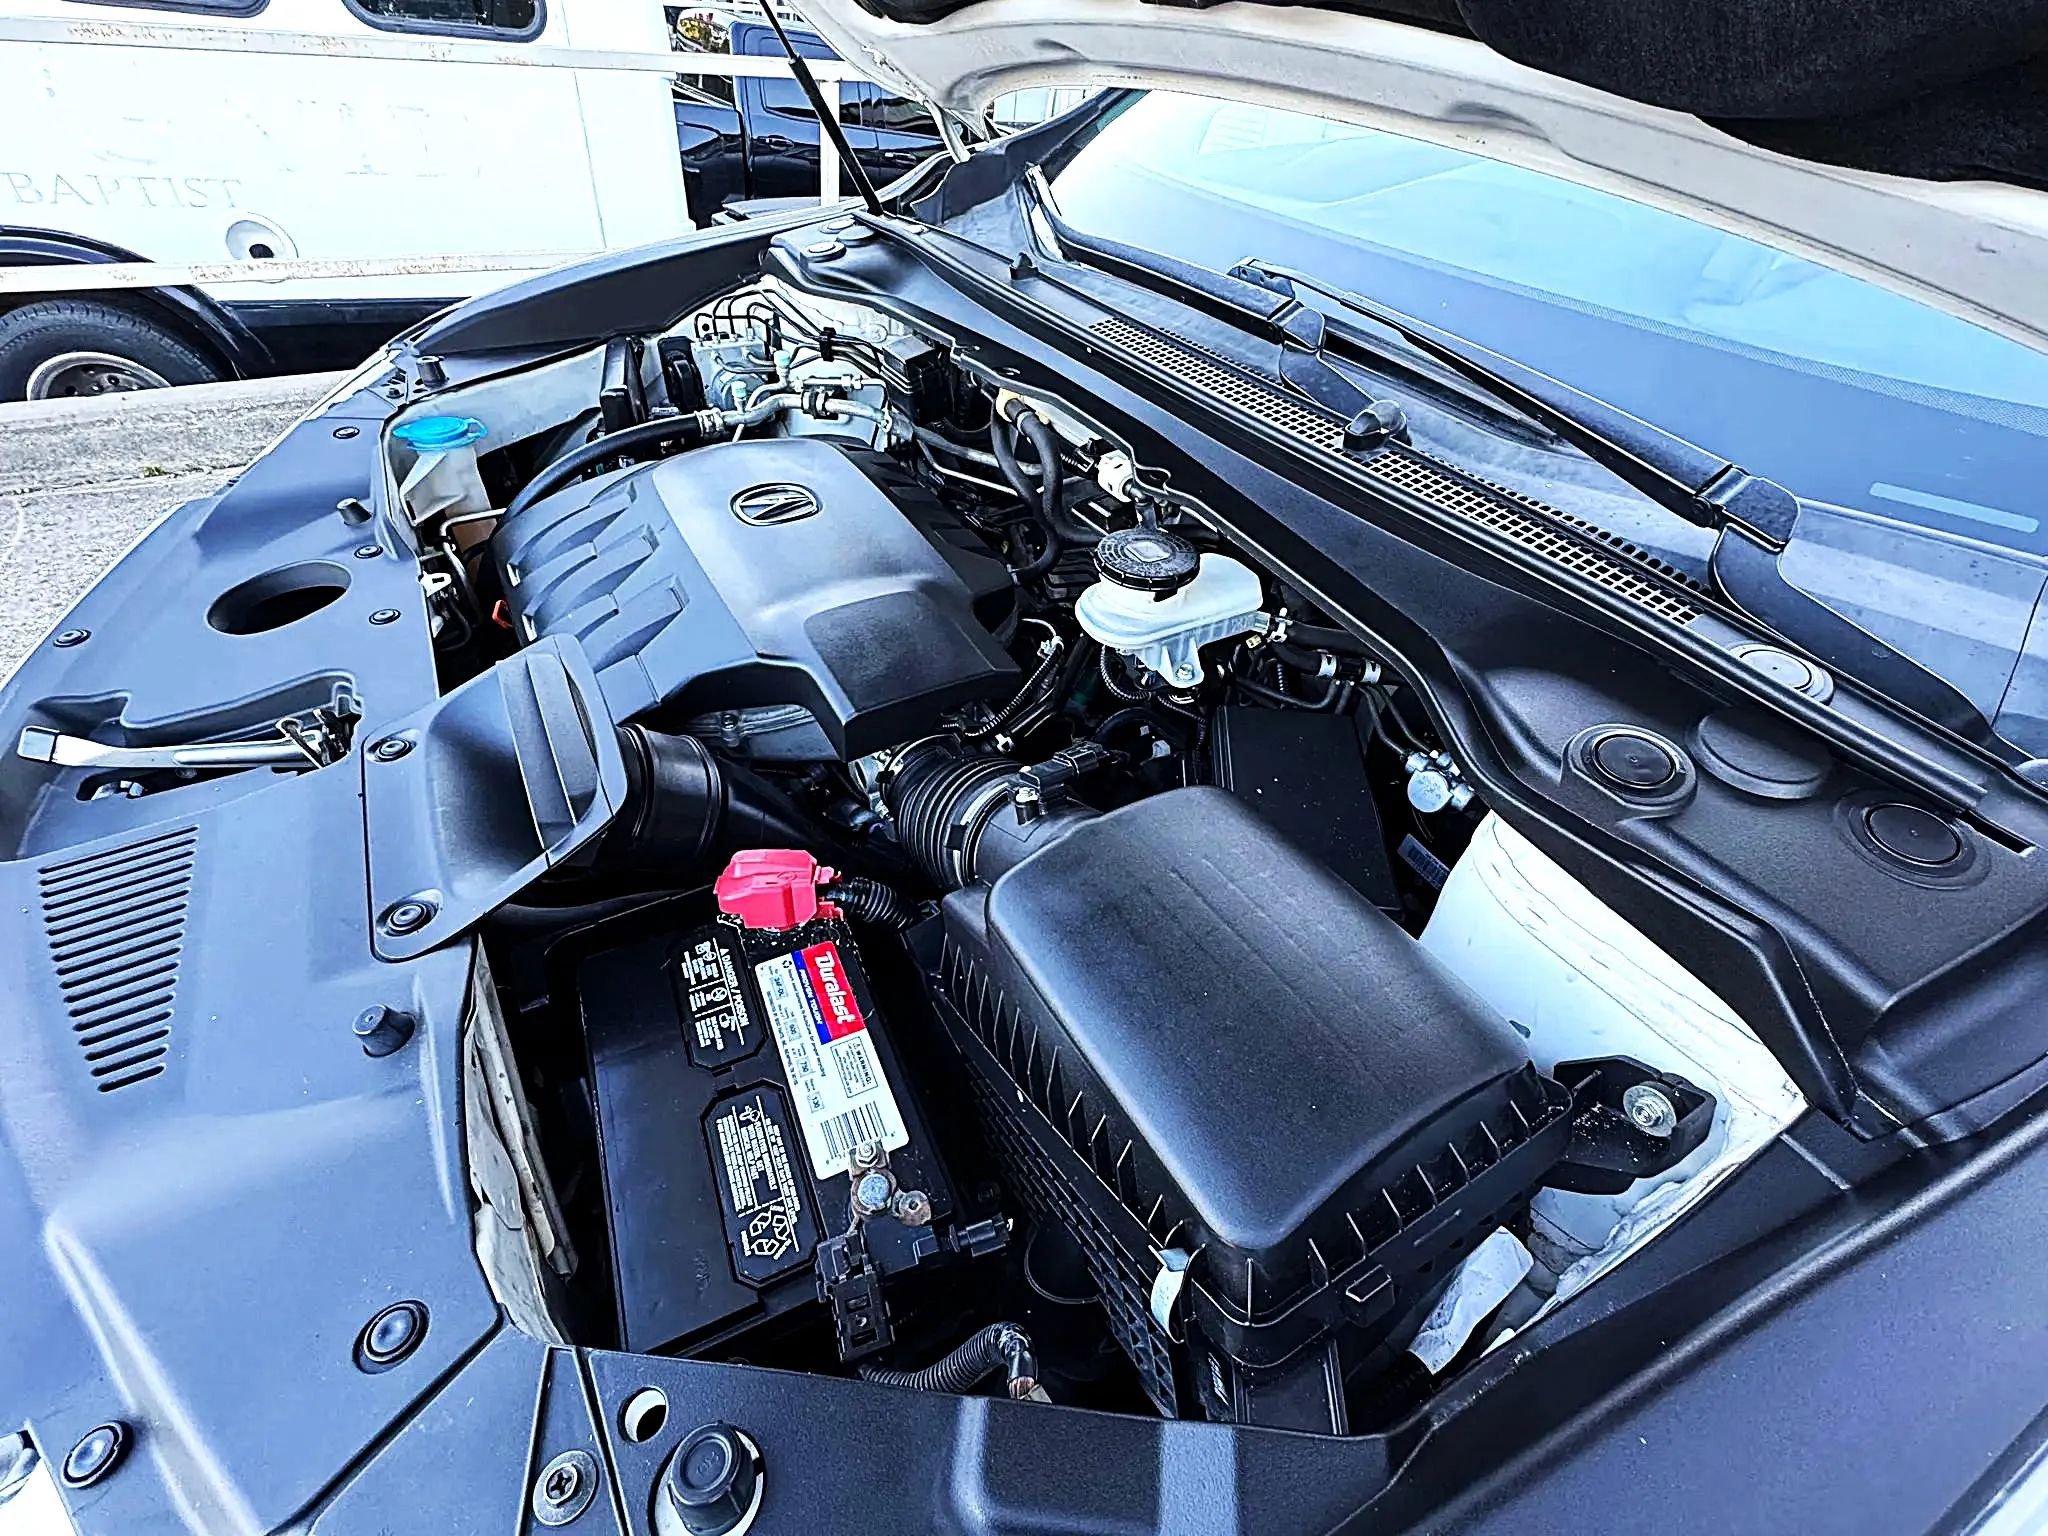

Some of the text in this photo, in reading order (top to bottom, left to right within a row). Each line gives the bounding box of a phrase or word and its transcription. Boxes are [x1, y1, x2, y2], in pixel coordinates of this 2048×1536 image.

[0, 172, 241, 208] BAPTIST
[721, 955, 738, 987] DANGER
[732, 993, 749, 1026] POISON
[797, 968, 824, 1025] PROVEN TOUGH
[815, 951, 856, 1025] Duralast
[854, 1049, 873, 1085] WARNING:
